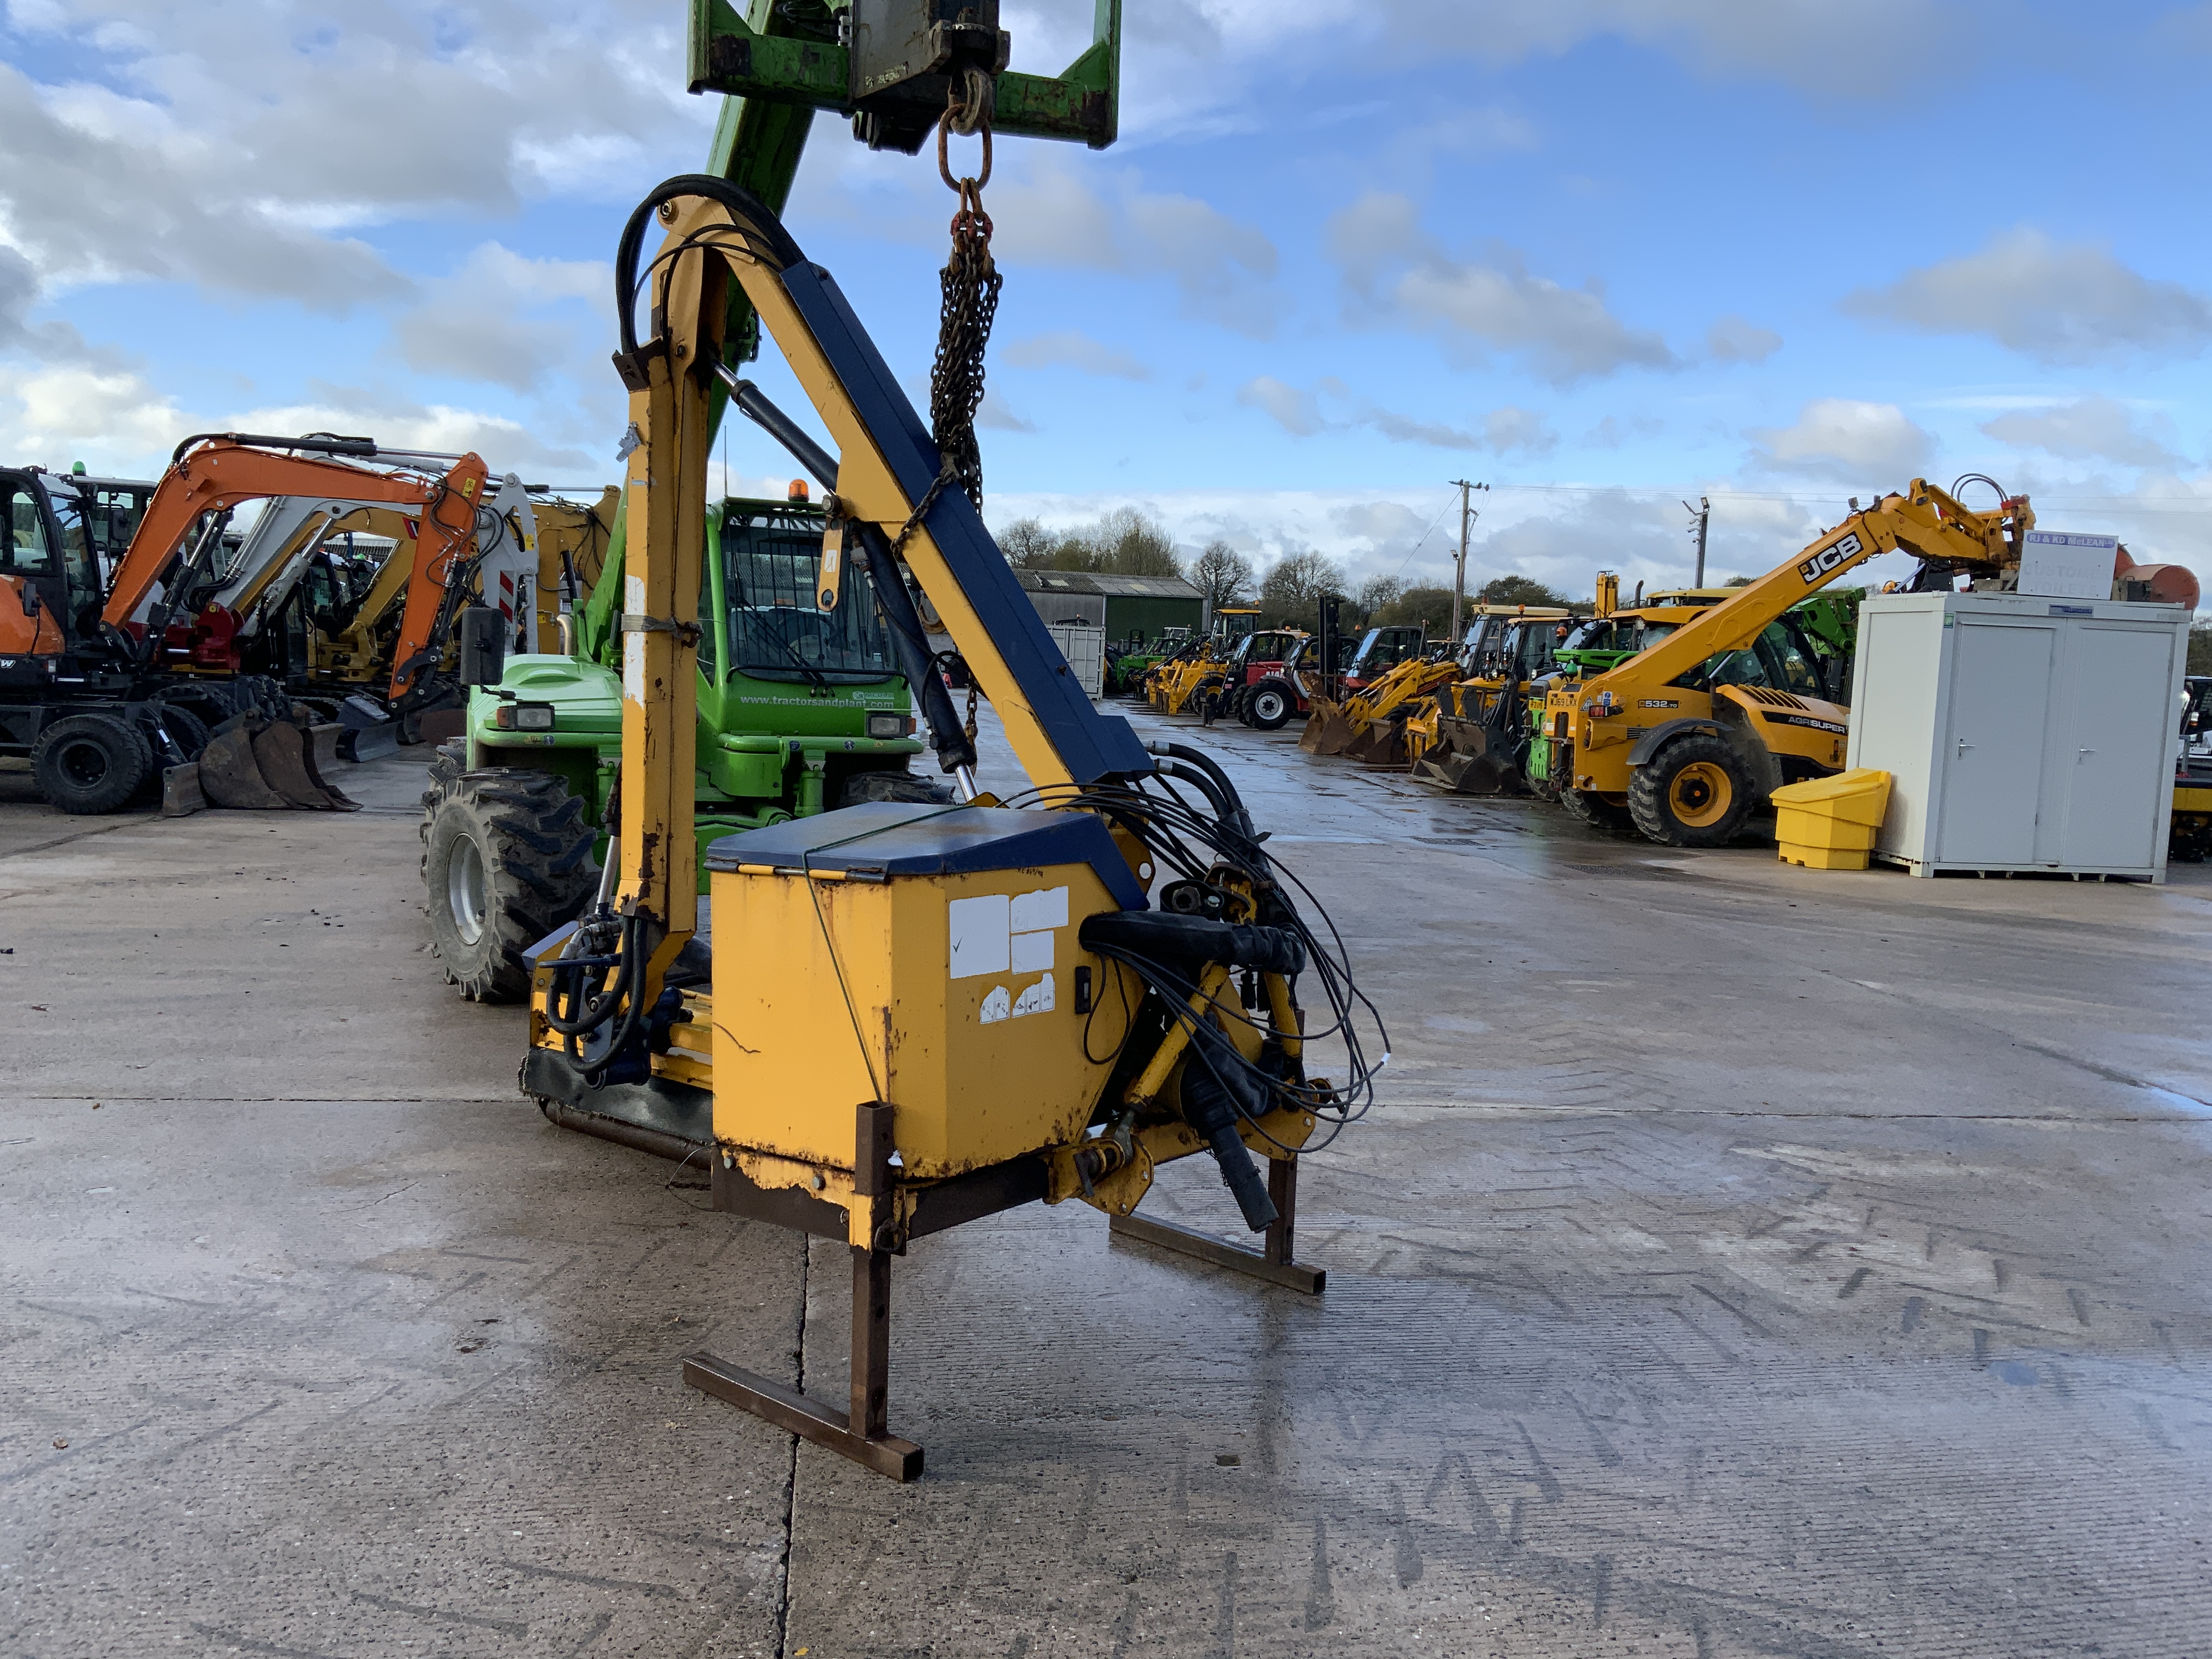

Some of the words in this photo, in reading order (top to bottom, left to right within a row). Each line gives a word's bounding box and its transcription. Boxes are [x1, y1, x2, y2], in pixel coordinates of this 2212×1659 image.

[2052, 535, 2066, 544] KD
[2068, 537, 2104, 547] McLEAN
[1803, 534, 1861, 582] JCB
[741, 696, 894, 709] www.tractorsandplant.com
[1550, 698, 1564, 706] WJ69
[1566, 698, 1577, 707] LKX
